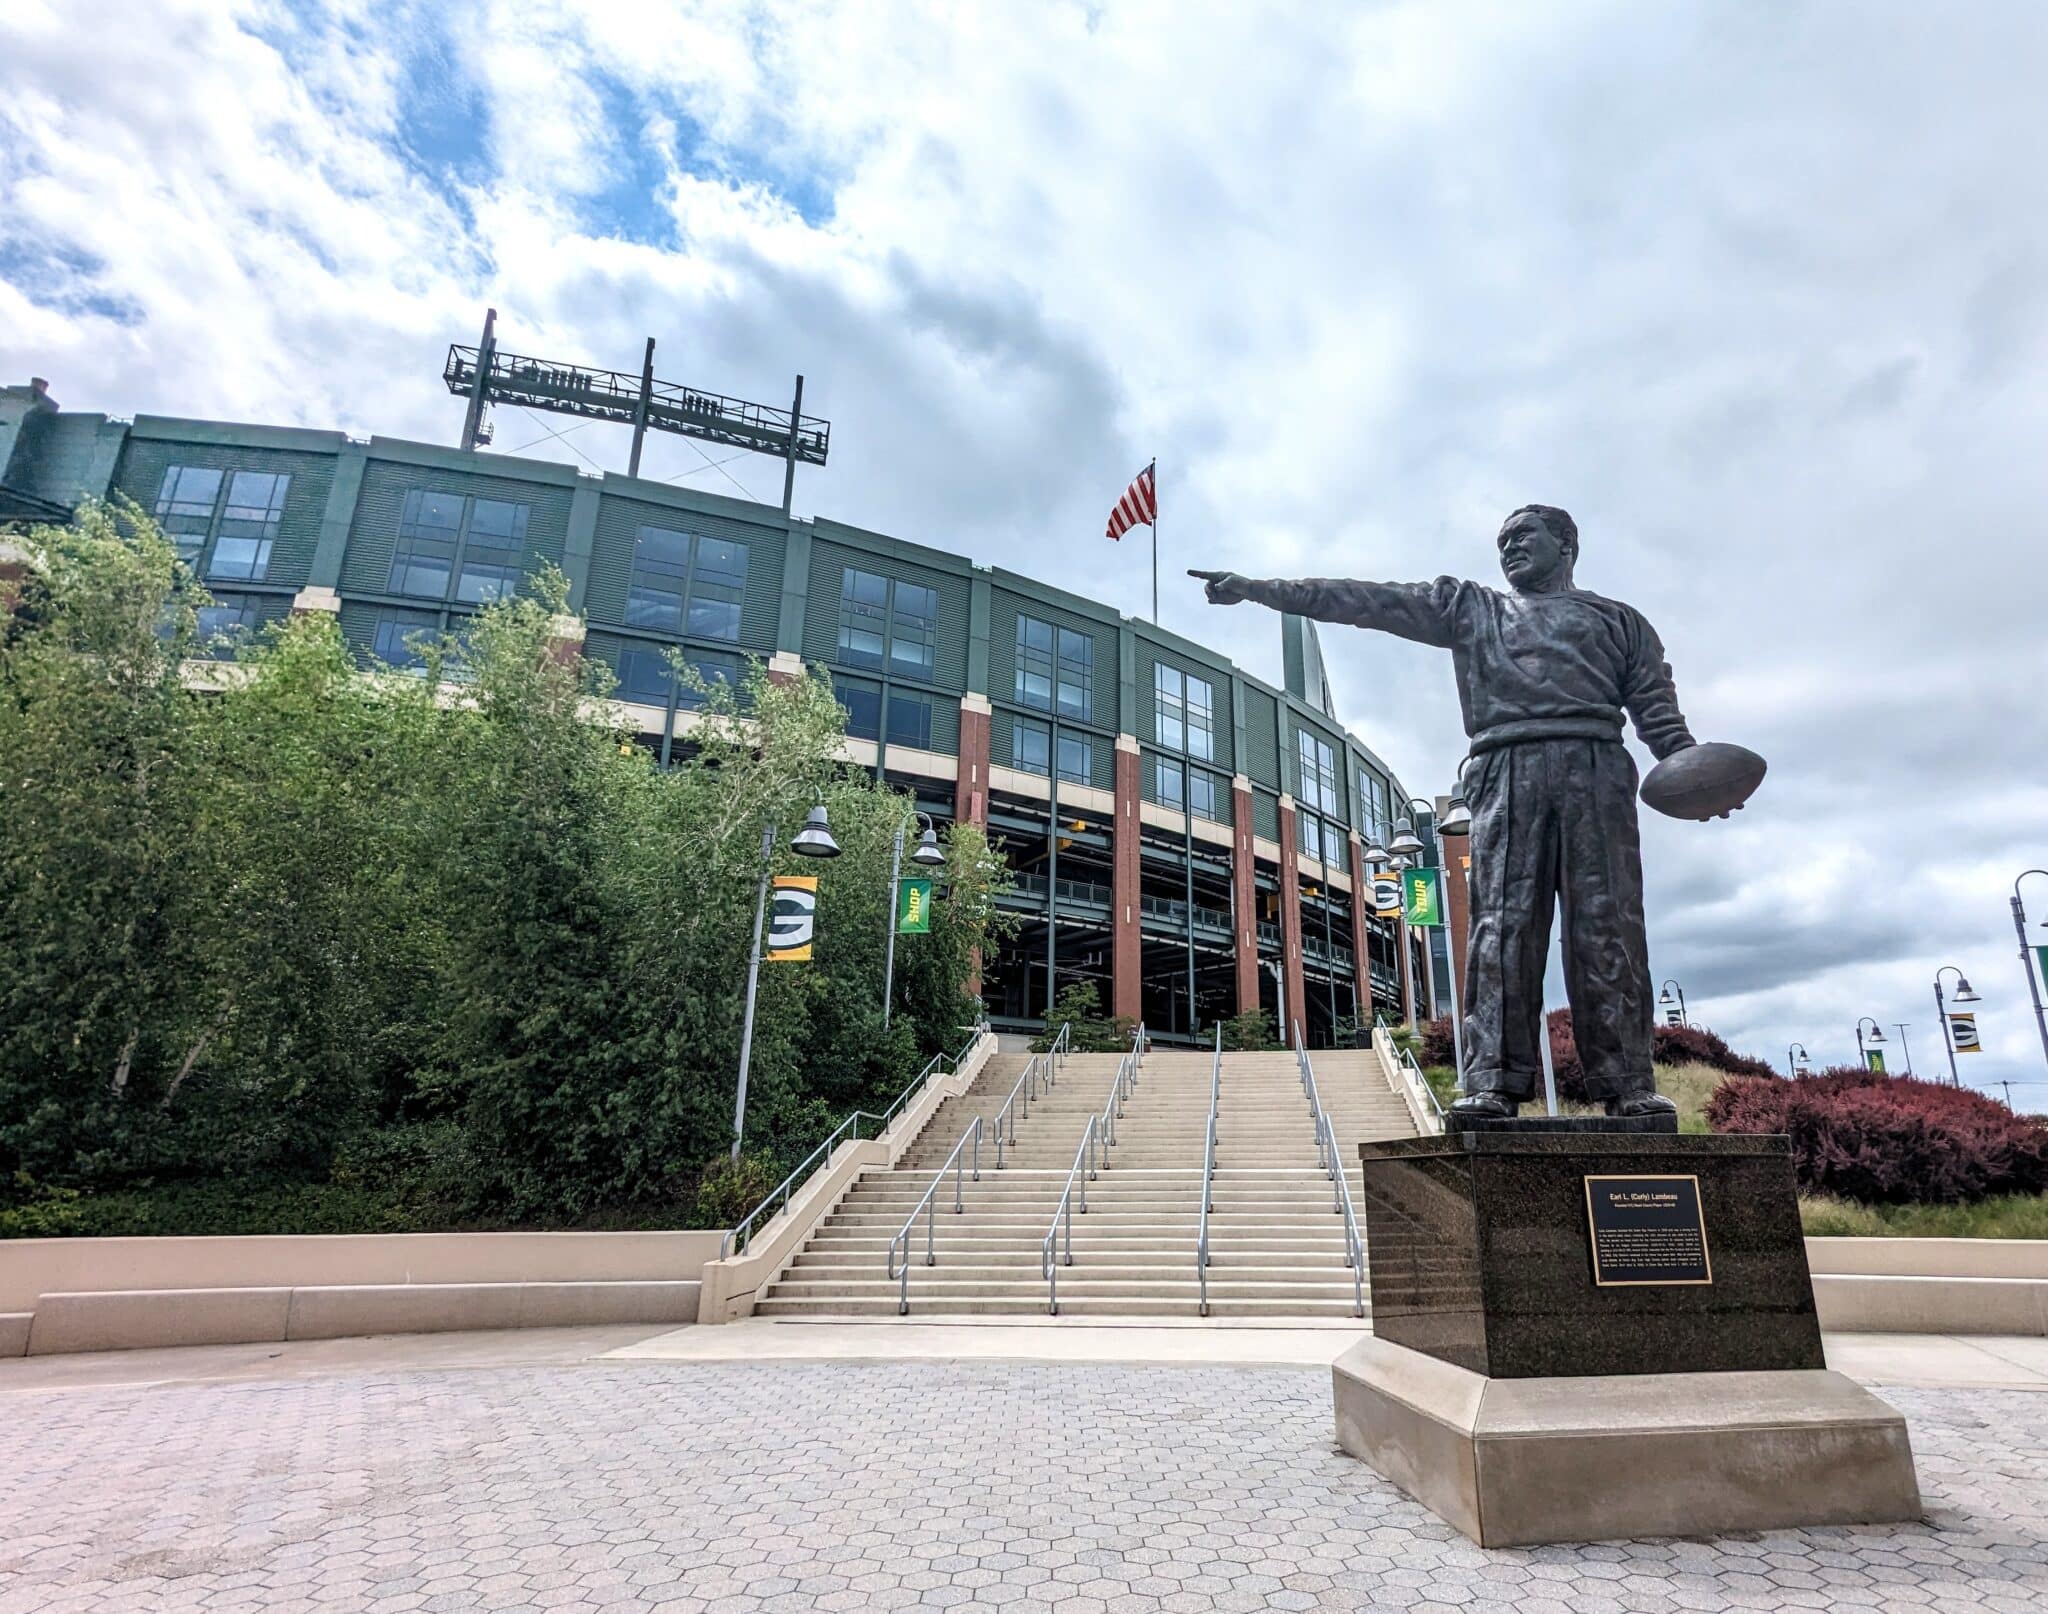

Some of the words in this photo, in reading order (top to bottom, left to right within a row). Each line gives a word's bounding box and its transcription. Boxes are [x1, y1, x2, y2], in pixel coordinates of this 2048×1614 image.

[908, 887, 921, 923] SHOP
[1413, 879, 1427, 913] TOUR
[1609, 1193, 1622, 1201] Earl
[1623, 1193, 1629, 1201] L.
[1630, 1193, 1650, 1202] (Curly)
[1651, 1193, 1678, 1201] Lambeau
